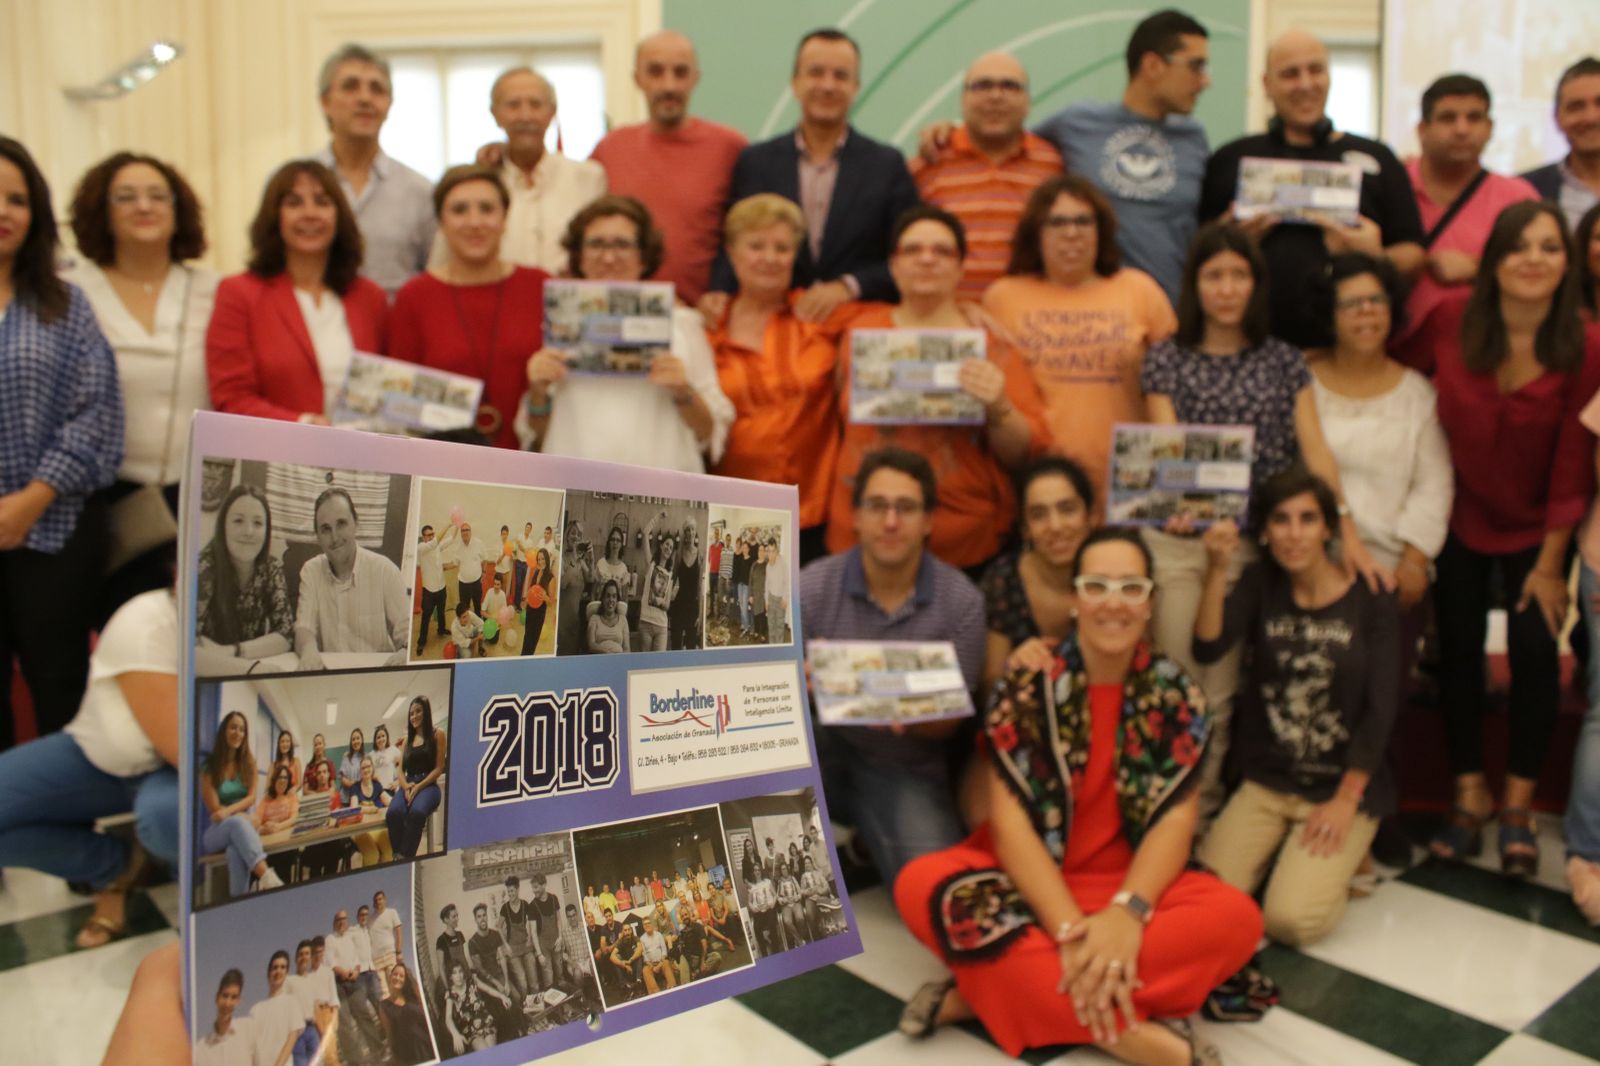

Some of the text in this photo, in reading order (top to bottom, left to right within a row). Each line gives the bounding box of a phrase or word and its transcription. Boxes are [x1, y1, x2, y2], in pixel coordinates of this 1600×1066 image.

[742, 684, 755, 693] Para
[649, 687, 715, 714] Borderline
[753, 695, 780, 704] Personas
[652, 727, 716, 742] Asociación de Granada
[477, 686, 620, 809] 2018
[474, 839, 565, 866] esencial
